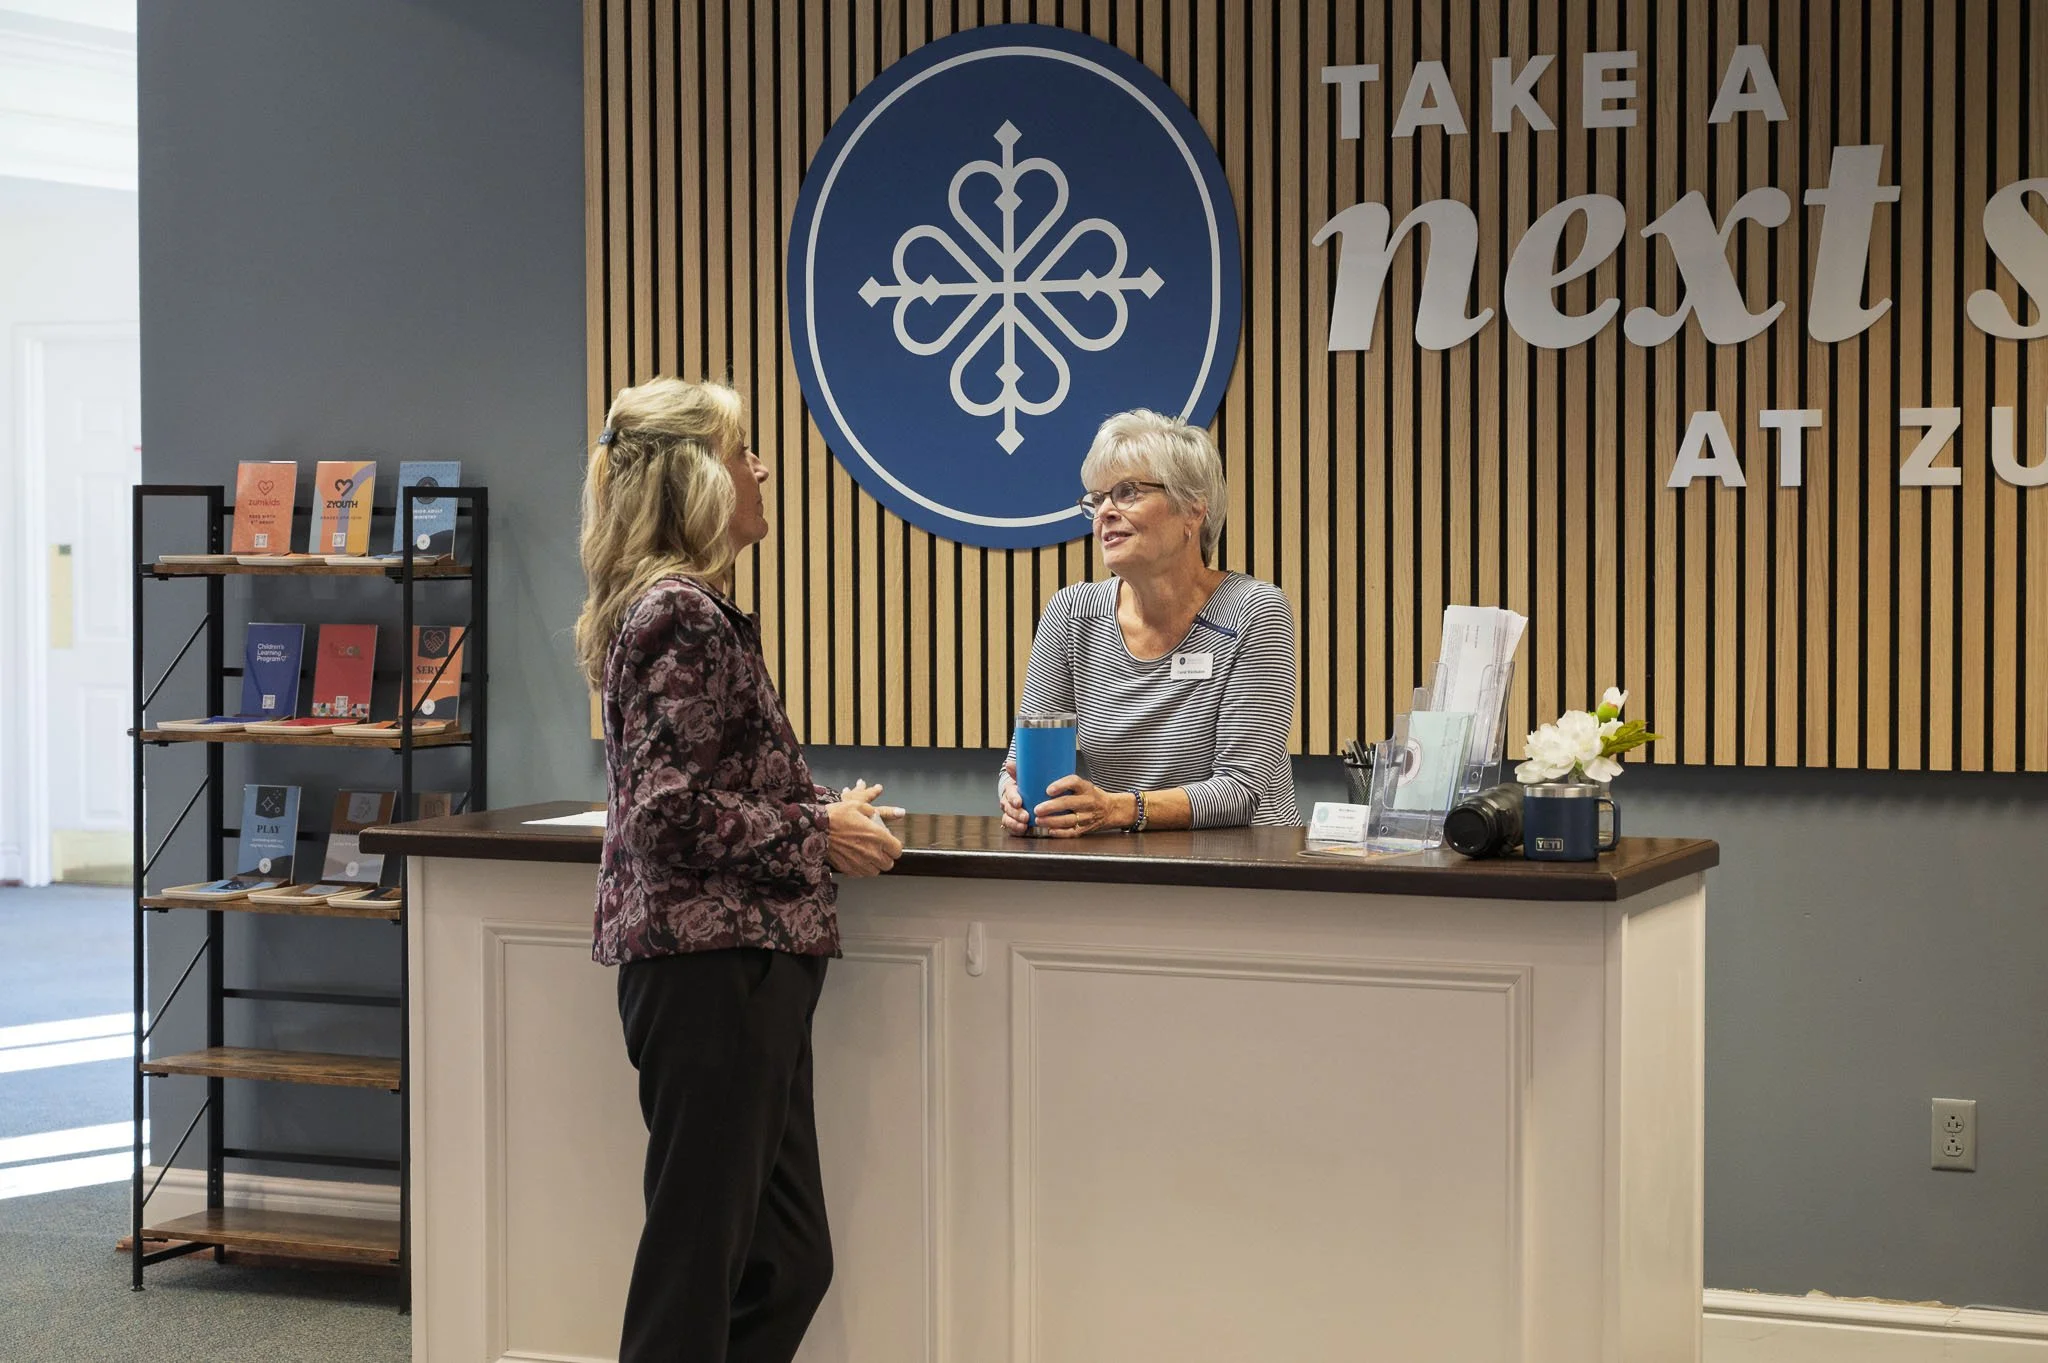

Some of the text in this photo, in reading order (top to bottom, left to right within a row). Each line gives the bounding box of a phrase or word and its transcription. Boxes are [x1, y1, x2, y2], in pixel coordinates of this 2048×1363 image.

[1321, 44, 1789, 140] TAKE A
[1312, 144, 1901, 352] next
[1666, 406, 2048, 489] AT ZU
[326, 500, 359, 509] ZYOUTH
[257, 649, 282, 657] Learning
[256, 655, 281, 663] Program
[256, 824, 281, 834] PLAY
[1537, 840, 1561, 849] YETI
